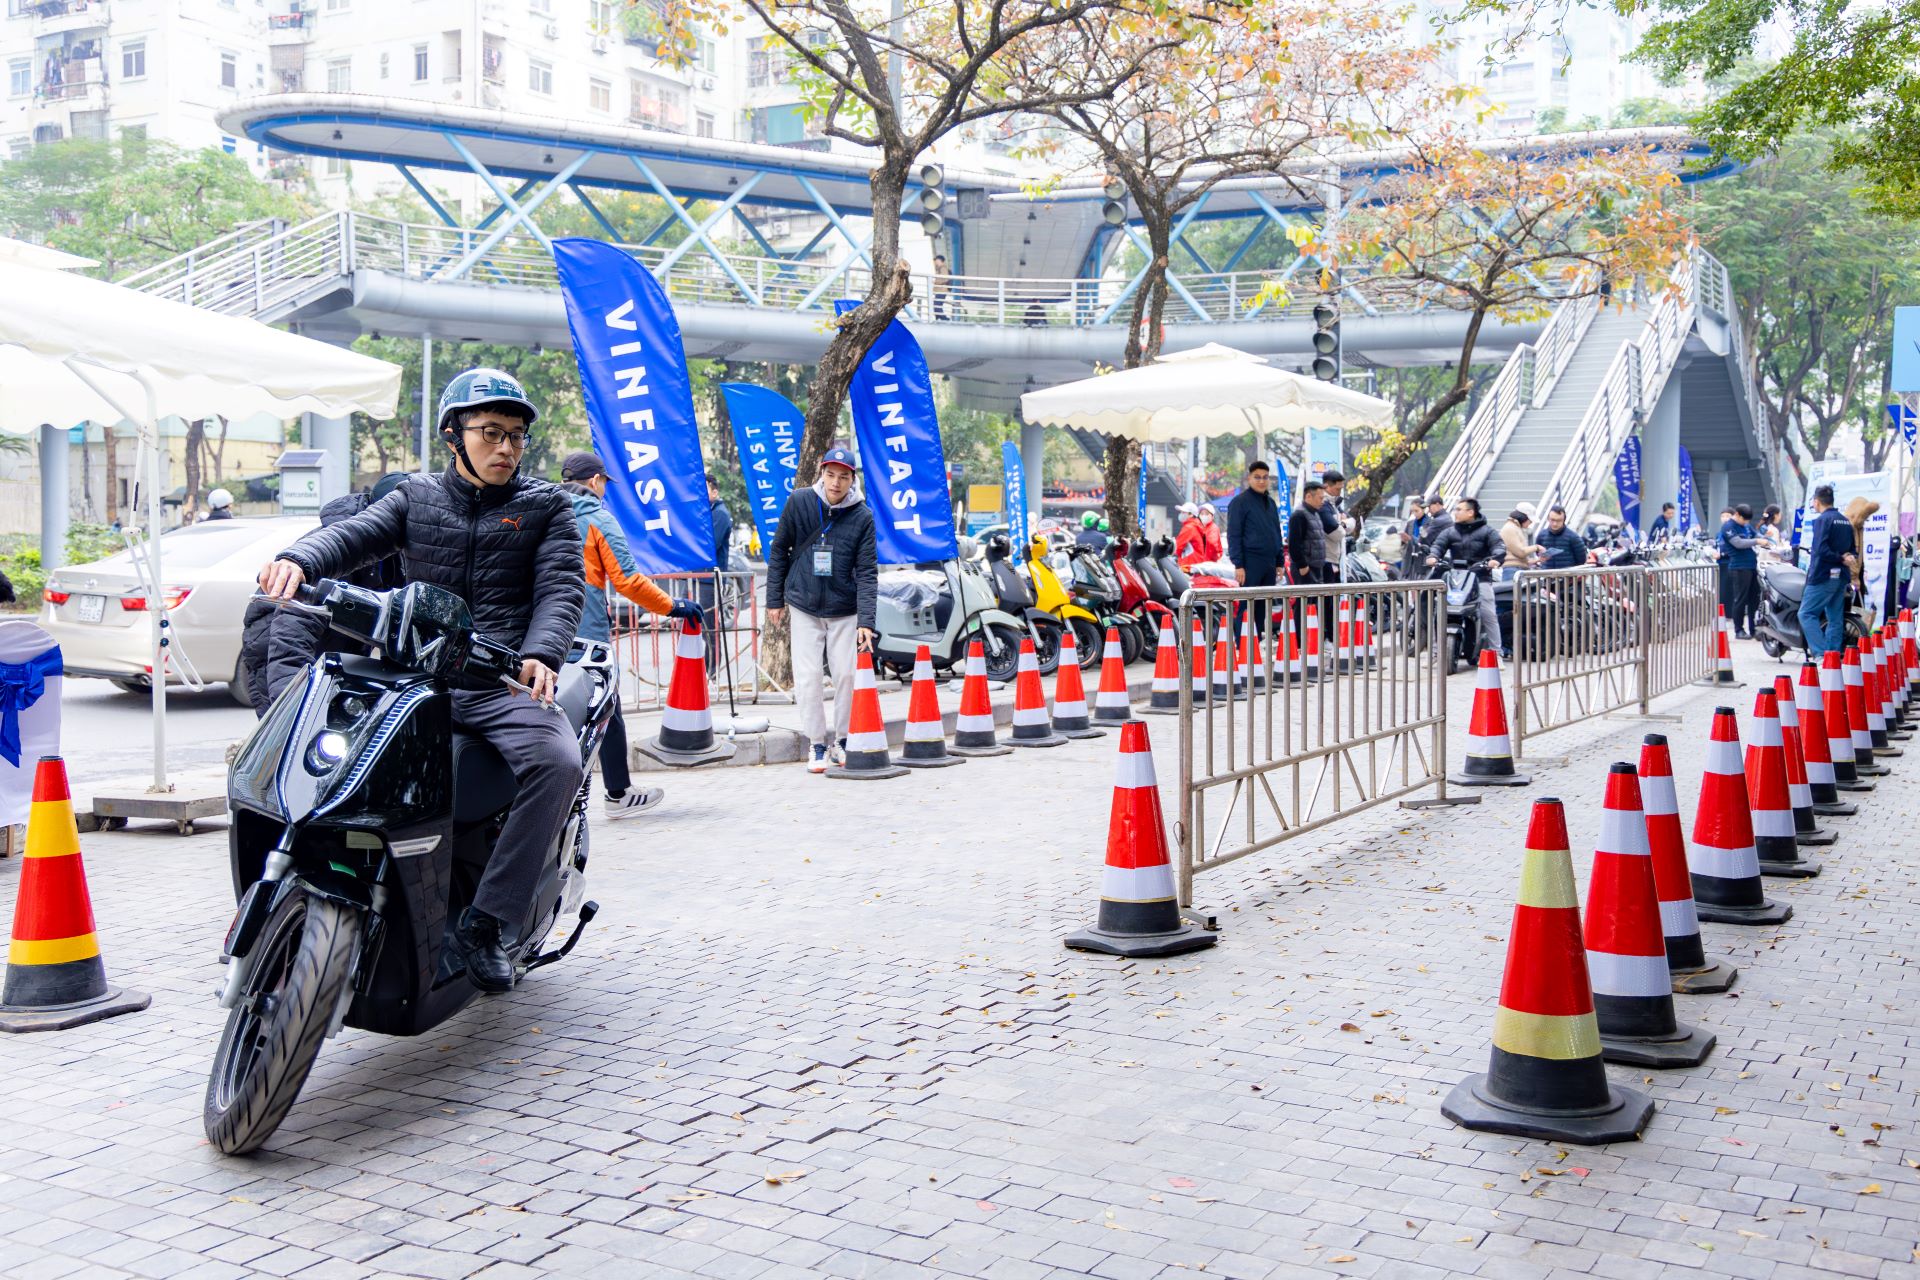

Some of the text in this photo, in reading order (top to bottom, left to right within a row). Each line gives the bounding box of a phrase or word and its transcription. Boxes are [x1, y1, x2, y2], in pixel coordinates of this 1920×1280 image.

[605, 299, 672, 537] VINFAST
[771, 421, 798, 469] ANH
[871, 350, 922, 535] VINFAST
